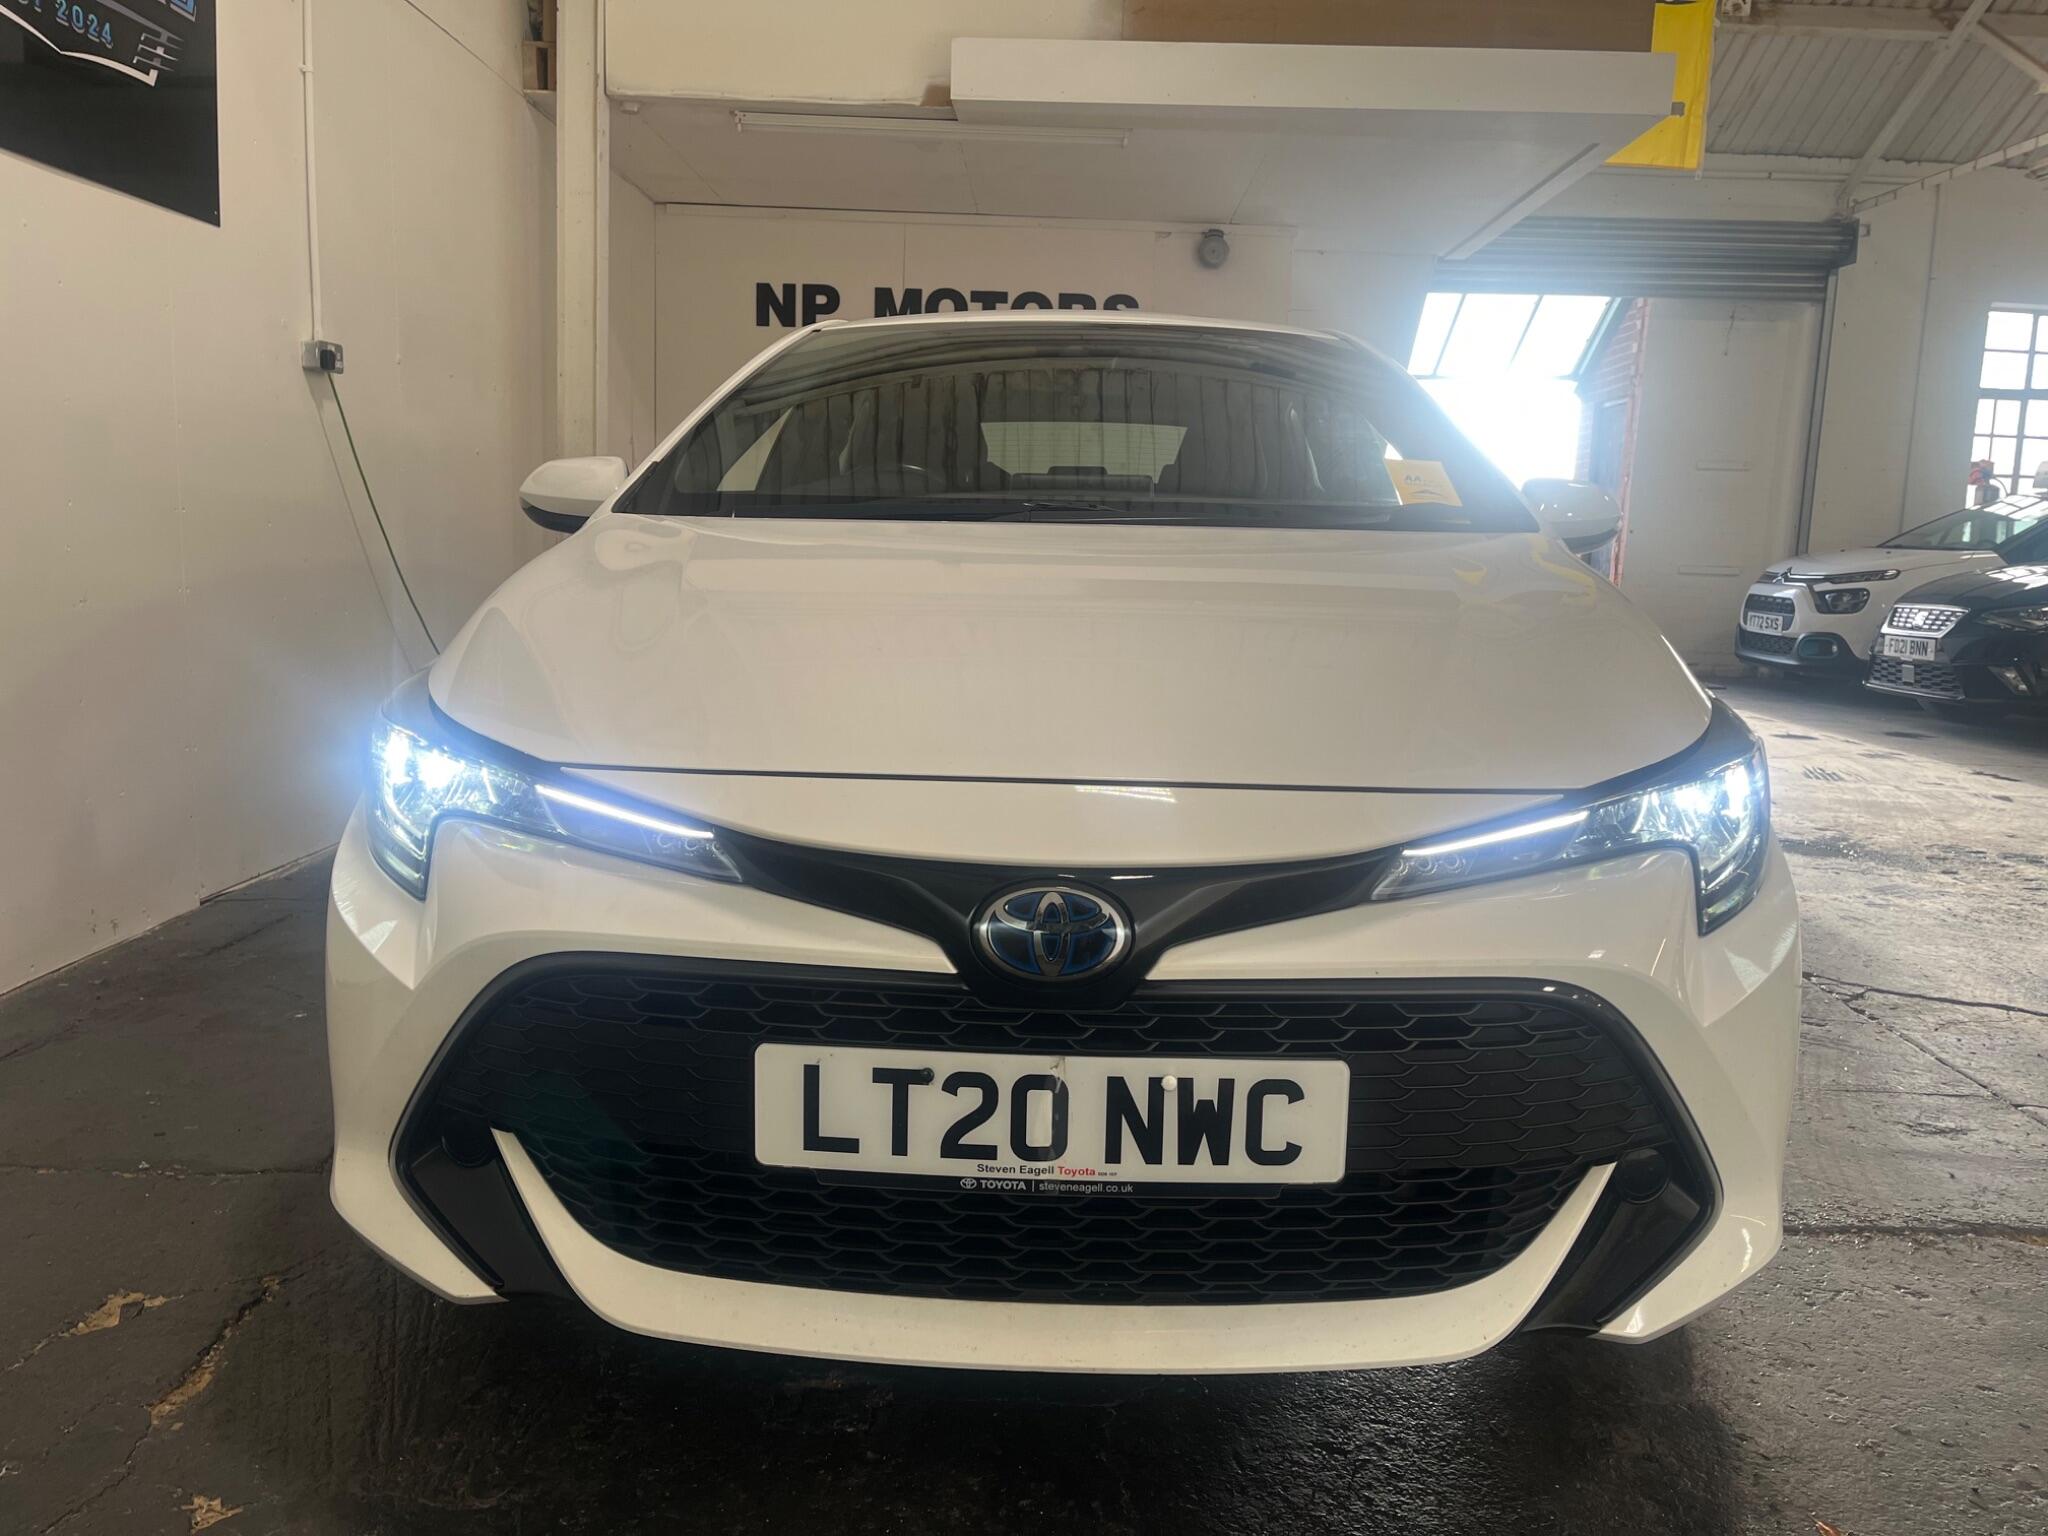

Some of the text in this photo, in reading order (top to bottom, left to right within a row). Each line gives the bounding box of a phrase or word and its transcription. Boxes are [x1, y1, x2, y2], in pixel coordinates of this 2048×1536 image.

[55, 0, 114, 49] 2024
[756, 282, 841, 327] NP
[1909, 639, 1929, 657] BNN
[803, 1063, 1306, 1167] LT20 NWC
[977, 1163, 1016, 1174] Steven
[1019, 1165, 1055, 1177] Eagell
[1058, 1166, 1096, 1178] Toyota
[980, 1179, 1134, 1194] TOYOTA steveneagell.co.uk
